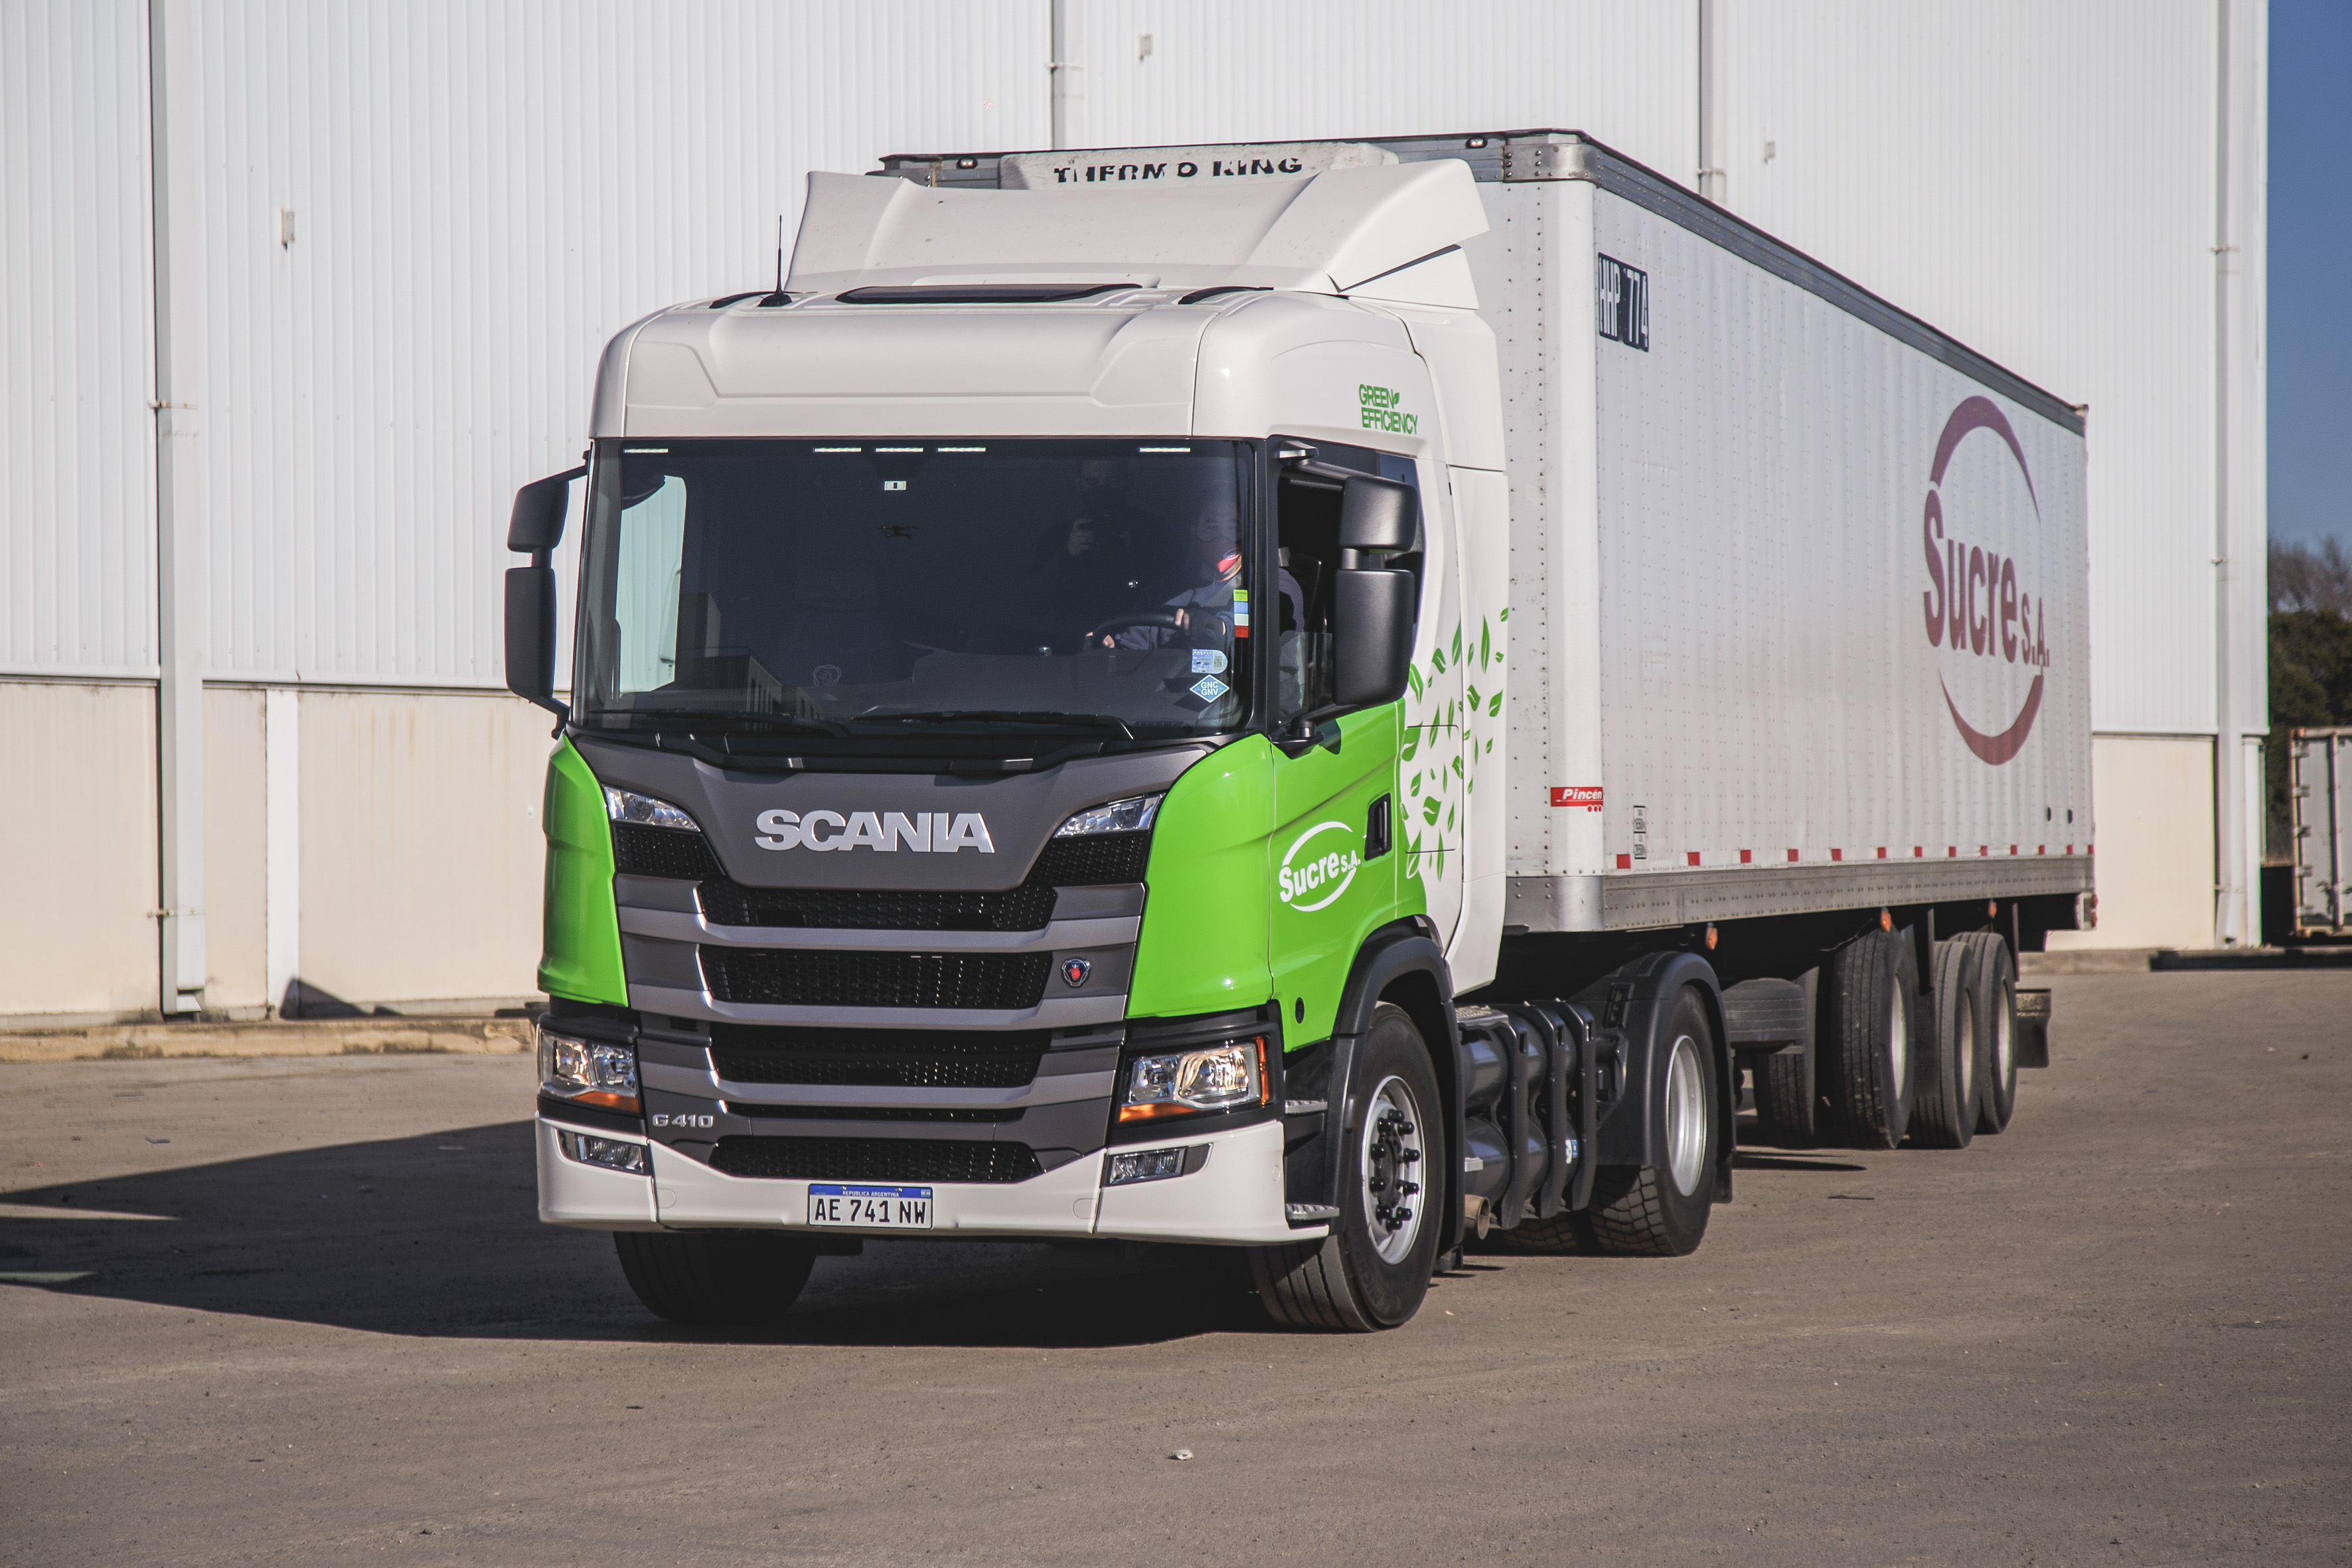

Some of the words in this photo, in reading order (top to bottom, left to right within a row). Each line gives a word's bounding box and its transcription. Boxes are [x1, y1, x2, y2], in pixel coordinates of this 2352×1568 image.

[1599, 257, 1620, 337] HHP
[1626, 268, 1648, 348] 774
[1359, 384, 1395, 409] GREEN
[1361, 407, 1418, 435] EFFICIENCY
[1923, 489, 2017, 664] Sucre
[1201, 688, 1219, 696] GNV
[755, 809, 995, 854] SCANIA
[1279, 852, 1340, 903] Sucre
[815, 1198, 841, 1221] AE
[850, 1200, 890, 1223] 741
[900, 1201, 926, 1224] NW
